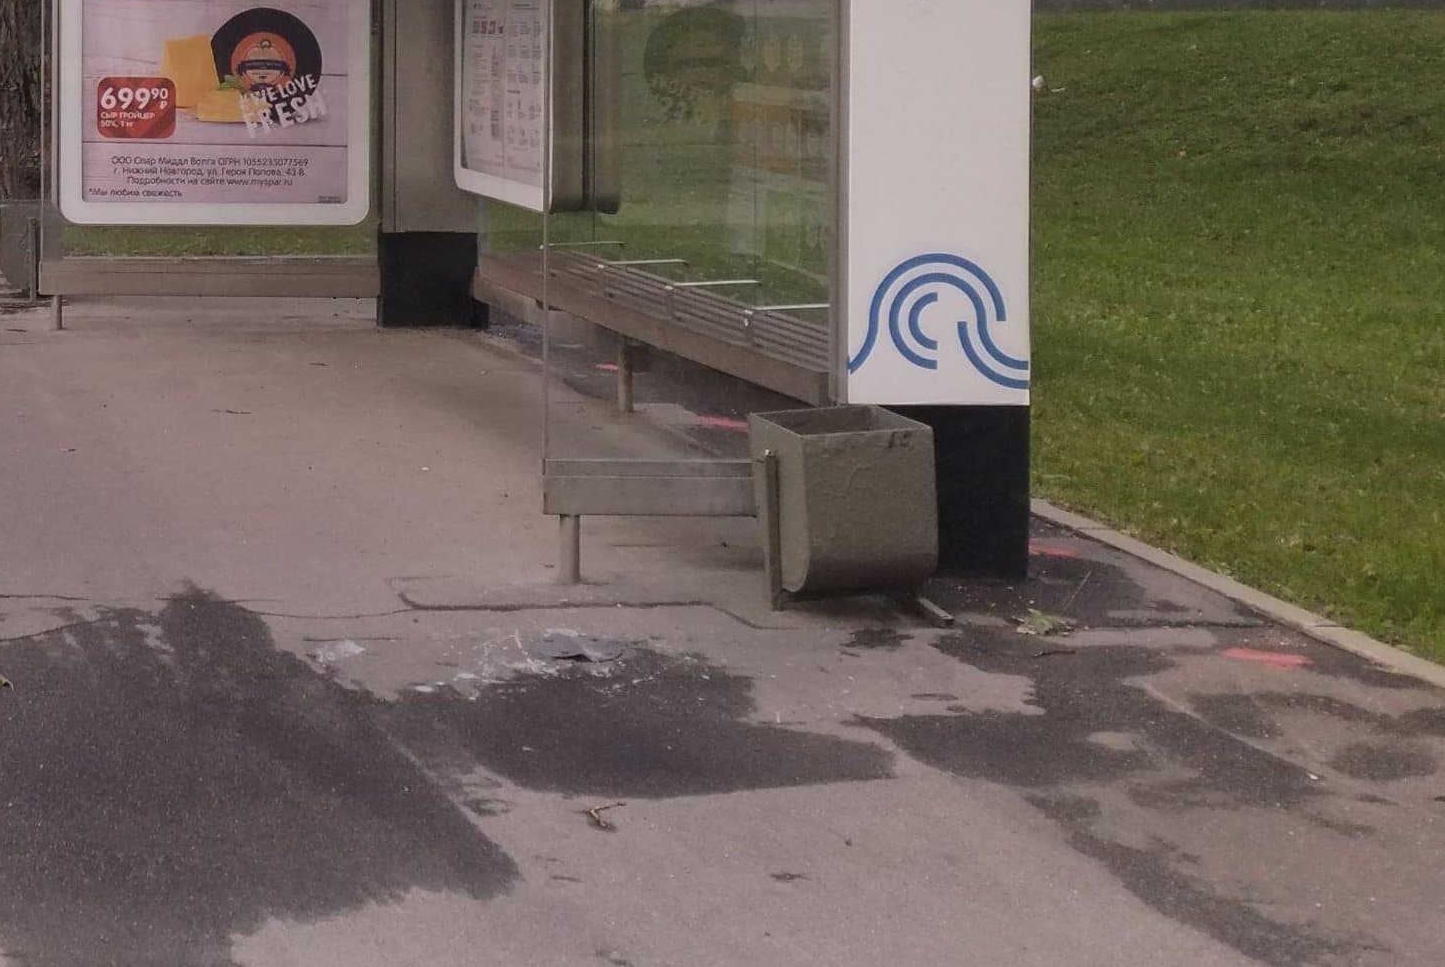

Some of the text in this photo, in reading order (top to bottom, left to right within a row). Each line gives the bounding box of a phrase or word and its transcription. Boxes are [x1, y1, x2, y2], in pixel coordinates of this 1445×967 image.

[278, 73, 317, 99] LOVE
[100, 87, 151, 110] 699
[111, 155, 132, 165] ООО
[134, 156, 156, 167] Спар
[191, 157, 216, 166] Волга
[218, 157, 241, 166] ОГРН
[126, 175, 186, 186] Подробности
[187, 177, 198, 185] на
[200, 176, 225, 186] сайте
[109, 188, 141, 197] любим
[142, 189, 183, 198] свежесть
